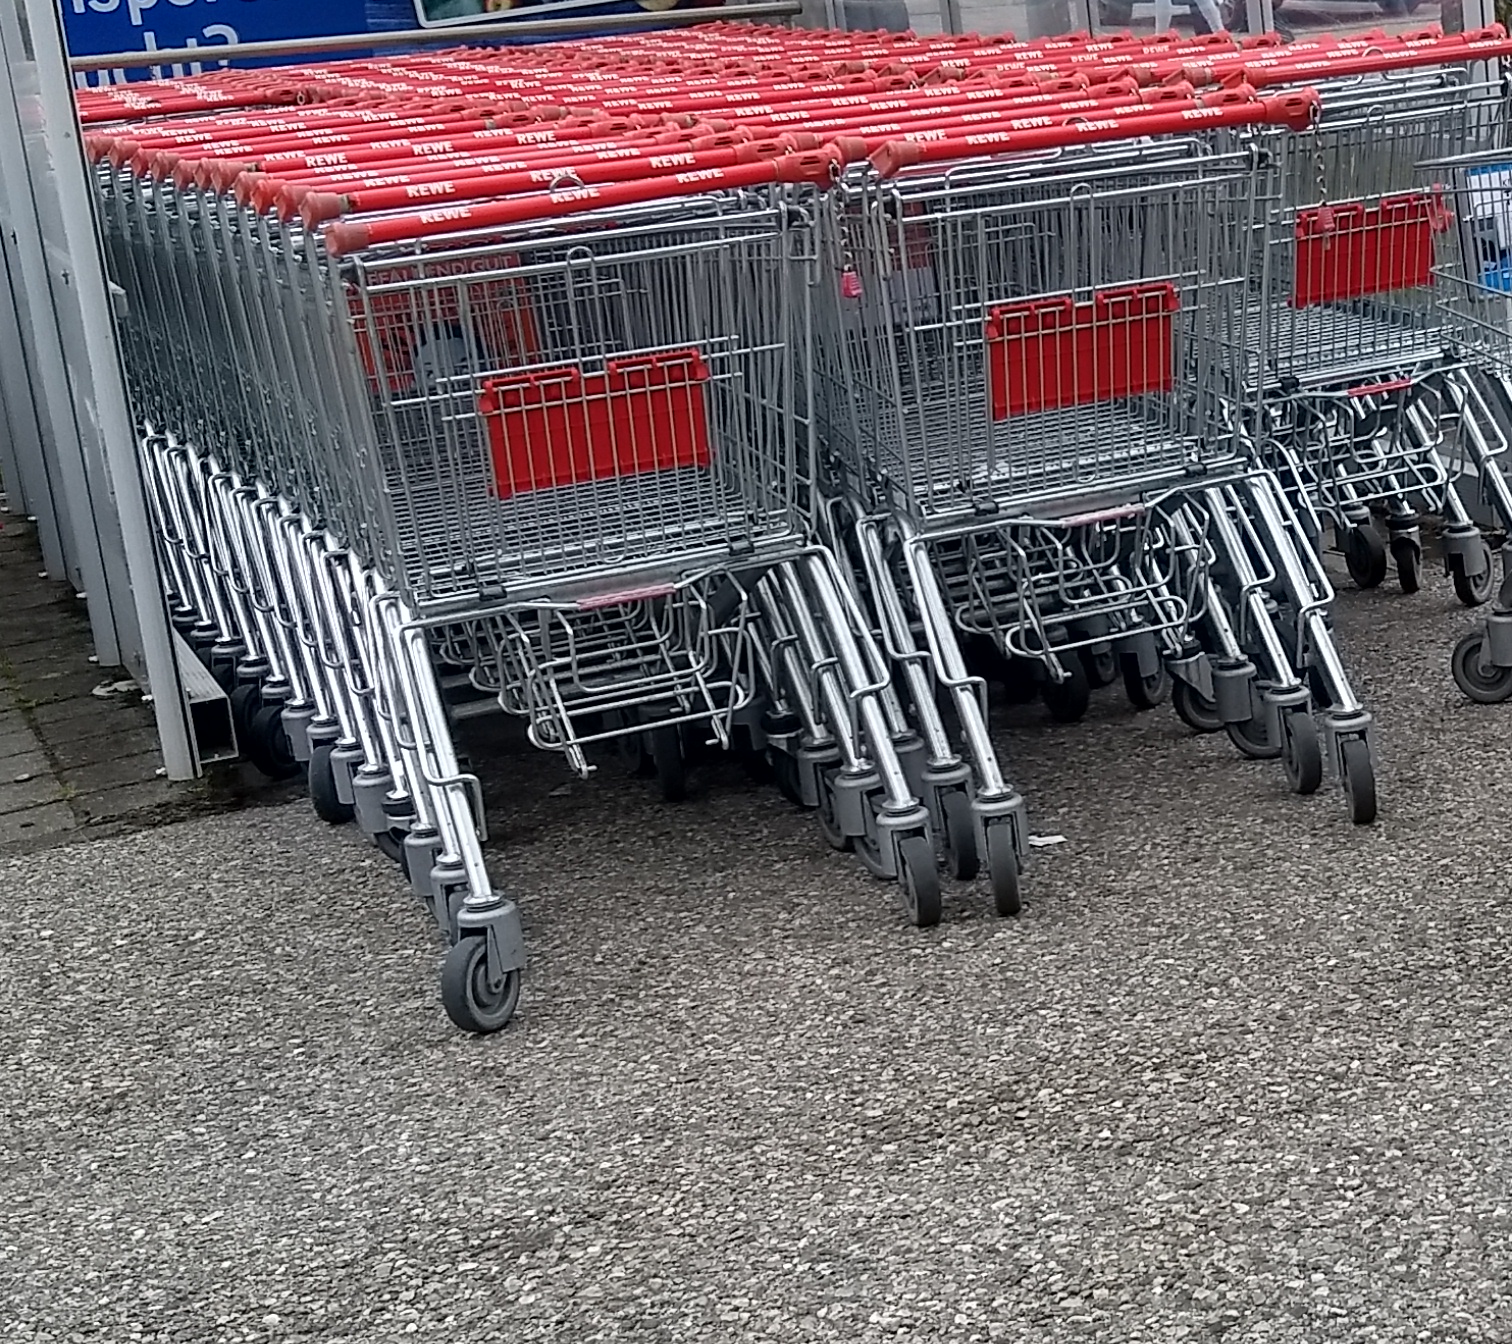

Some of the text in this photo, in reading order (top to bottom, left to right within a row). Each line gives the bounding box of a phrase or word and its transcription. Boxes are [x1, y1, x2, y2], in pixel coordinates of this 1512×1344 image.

[735, 106, 774, 116] REWE
[770, 111, 810, 122] REWE
[1182, 108, 1224, 119] REWE
[1011, 116, 1053, 129] REWE
[1075, 120, 1119, 132] REWE
[175, 133, 213, 143] REWE
[516, 131, 556, 144] REWE
[965, 132, 1010, 145] REWE
[412, 141, 454, 155] REWE
[305, 153, 348, 167] REWE
[650, 152, 696, 169] REWE
[676, 168, 725, 183] REWE
[406, 182, 456, 198] REWE
[550, 188, 600, 203] REWE
[419, 208, 473, 224] REWE
